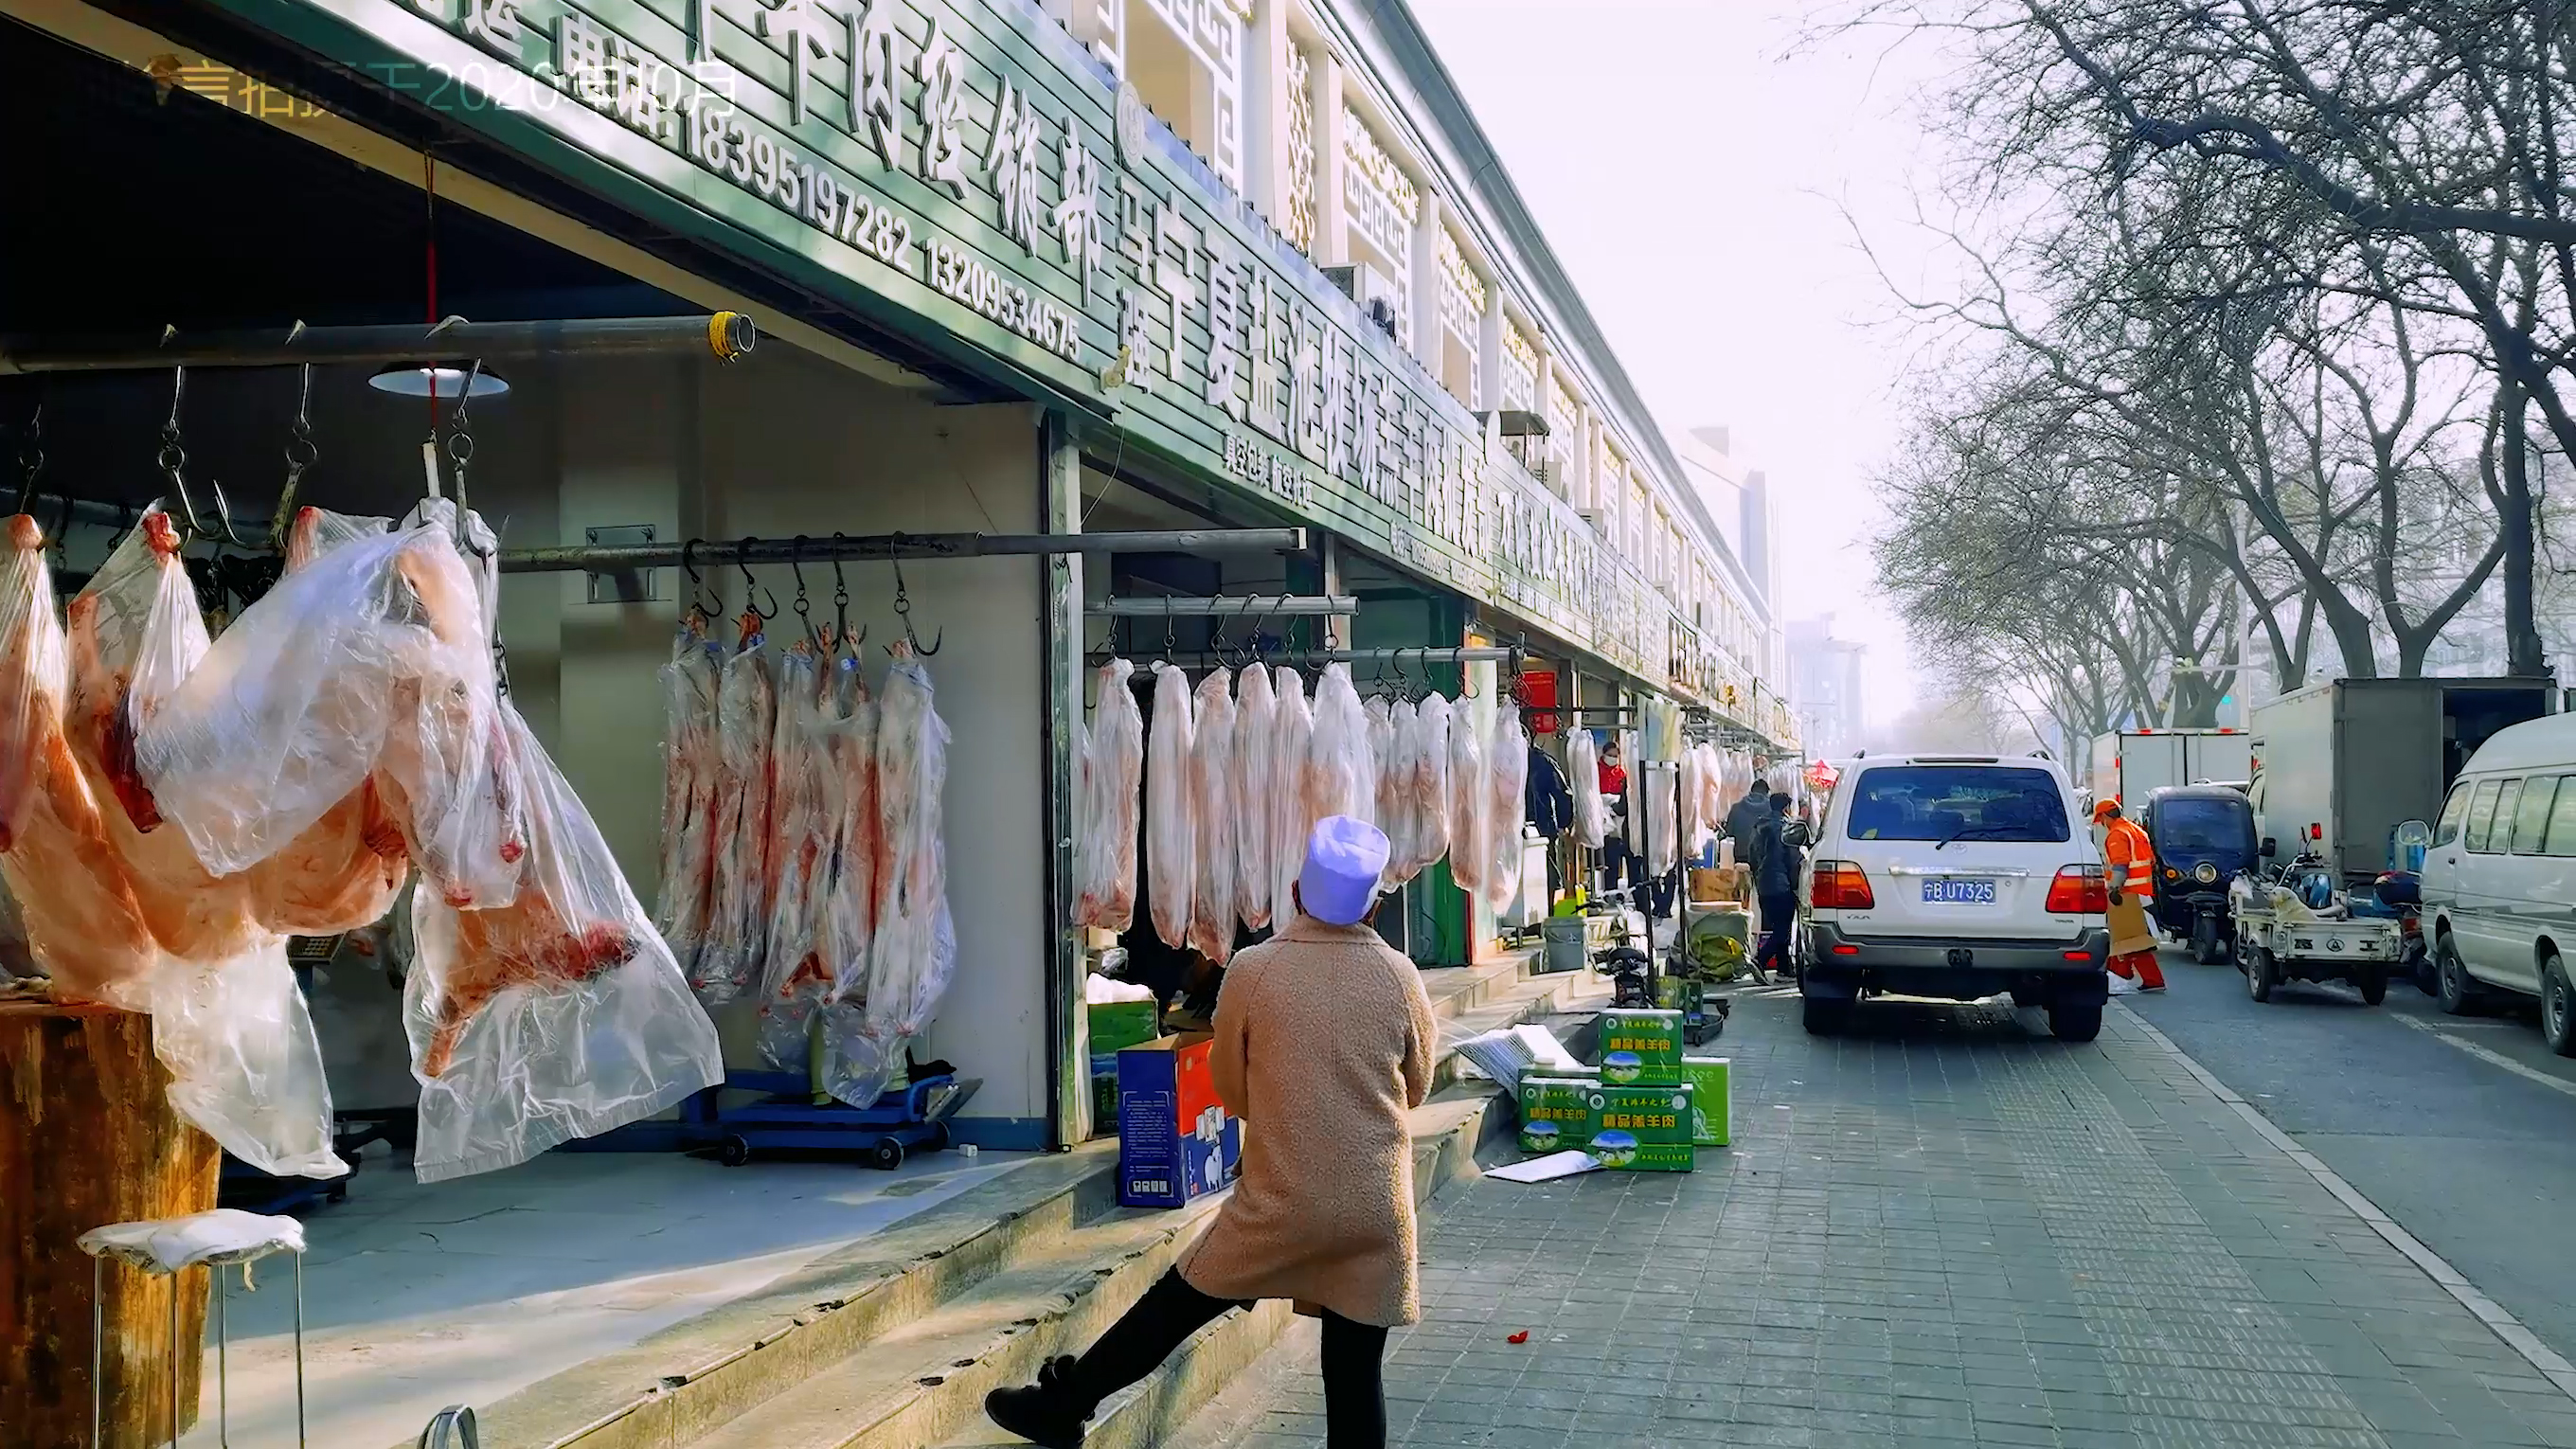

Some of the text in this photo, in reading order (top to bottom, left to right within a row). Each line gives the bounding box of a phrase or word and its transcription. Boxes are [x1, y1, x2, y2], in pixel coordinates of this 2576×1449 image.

[687, 104, 913, 273] 18395197282
[923, 235, 1081, 362] 13209534675
[1225, 428, 1314, 510] 真空包装 航空托运
[1602, 1113, 1676, 1129] 精品羔羊肉
